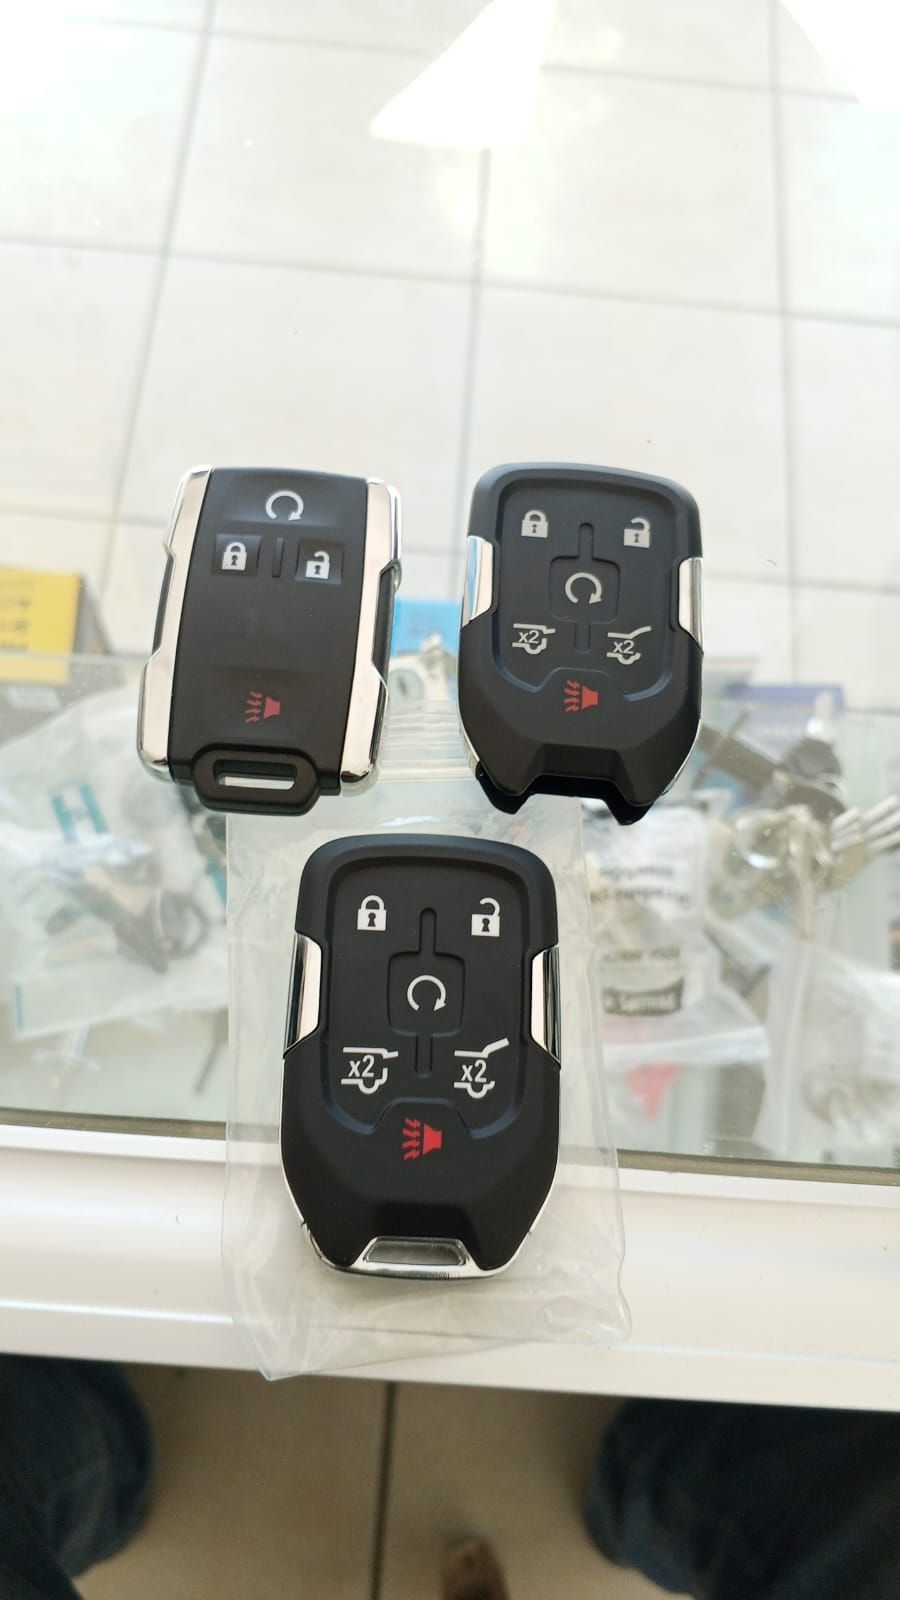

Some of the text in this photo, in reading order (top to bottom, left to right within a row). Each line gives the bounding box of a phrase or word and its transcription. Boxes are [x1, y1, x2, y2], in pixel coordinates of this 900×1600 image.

[518, 630, 540, 644] x2
[613, 640, 635, 654] x2
[348, 1055, 375, 1078] x2
[460, 1059, 487, 1083] x2
